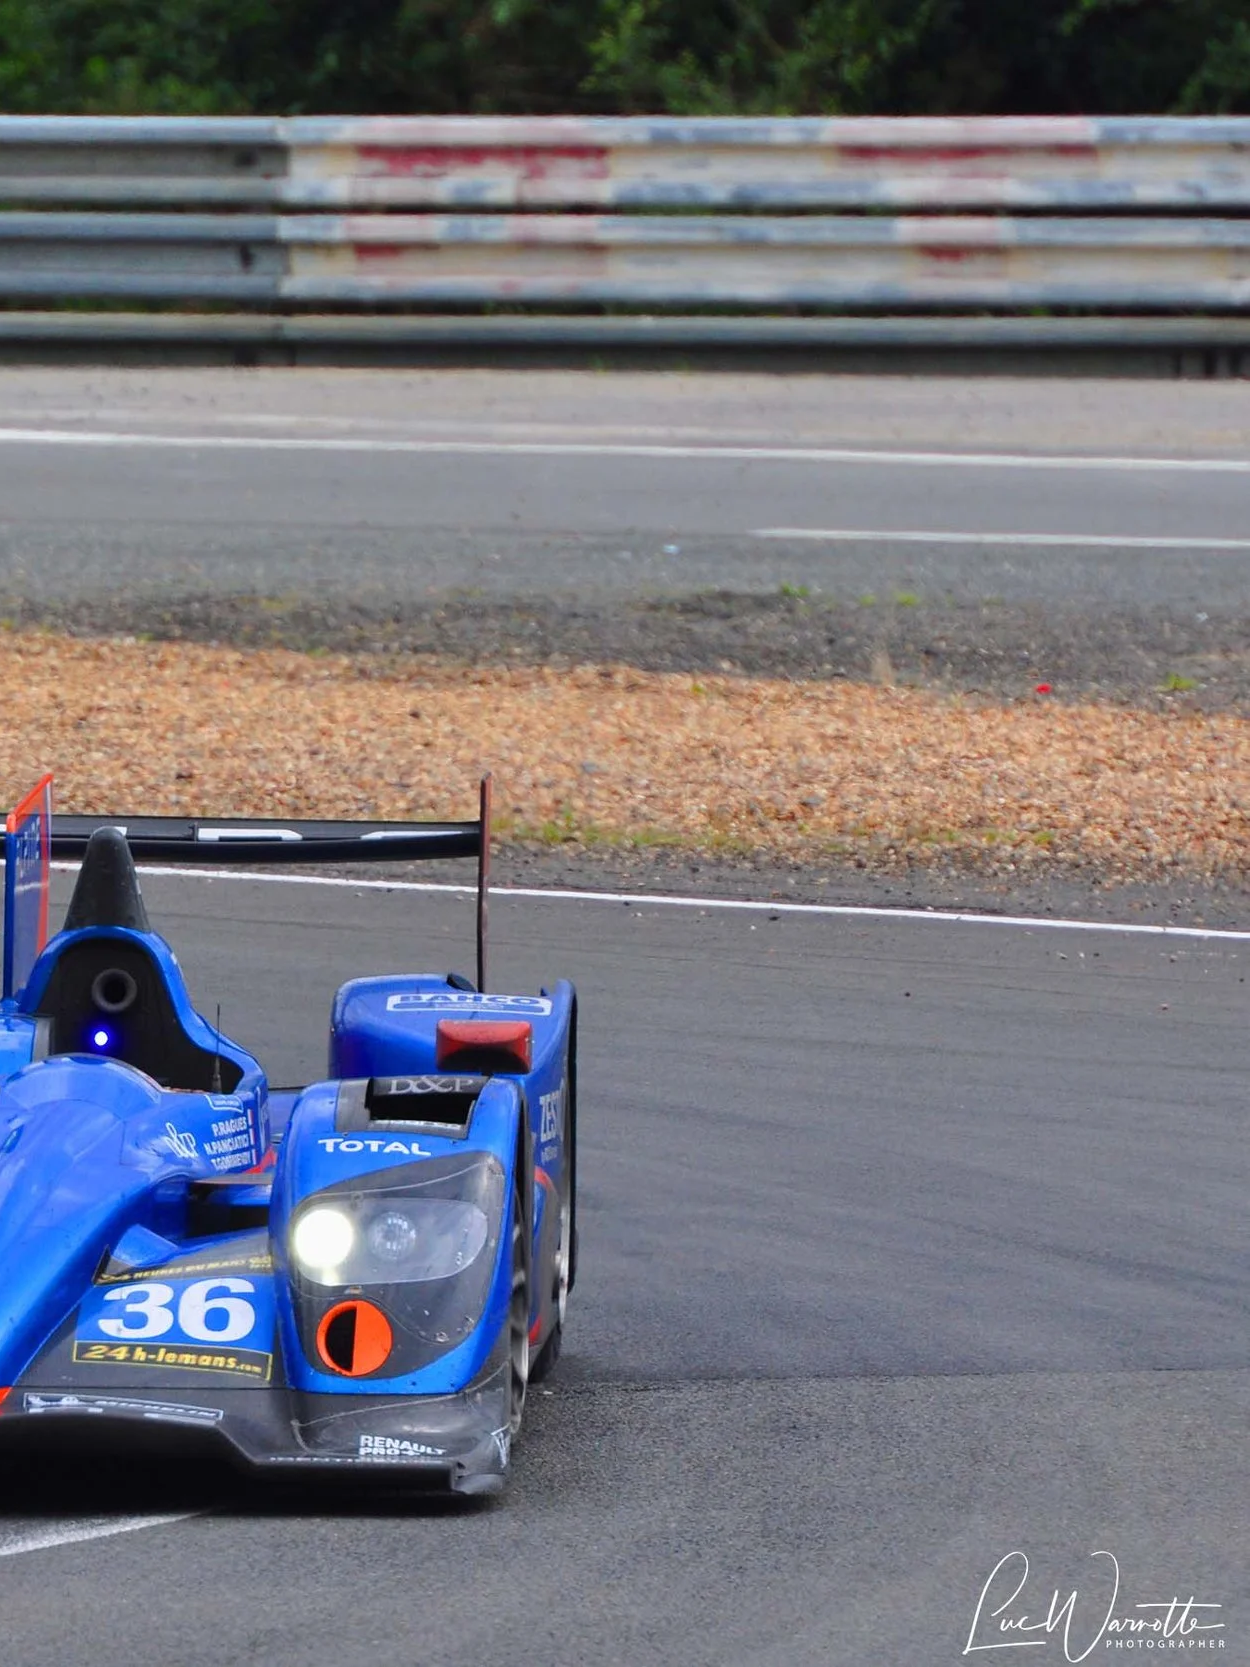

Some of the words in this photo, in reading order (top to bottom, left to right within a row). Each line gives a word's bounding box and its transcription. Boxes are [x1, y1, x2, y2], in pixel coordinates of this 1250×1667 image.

[388, 1075, 474, 1093] D&P
[318, 1138, 432, 1156] TOTAL
[98, 1278, 256, 1342] 36
[360, 1434, 447, 1455] RENAULT
